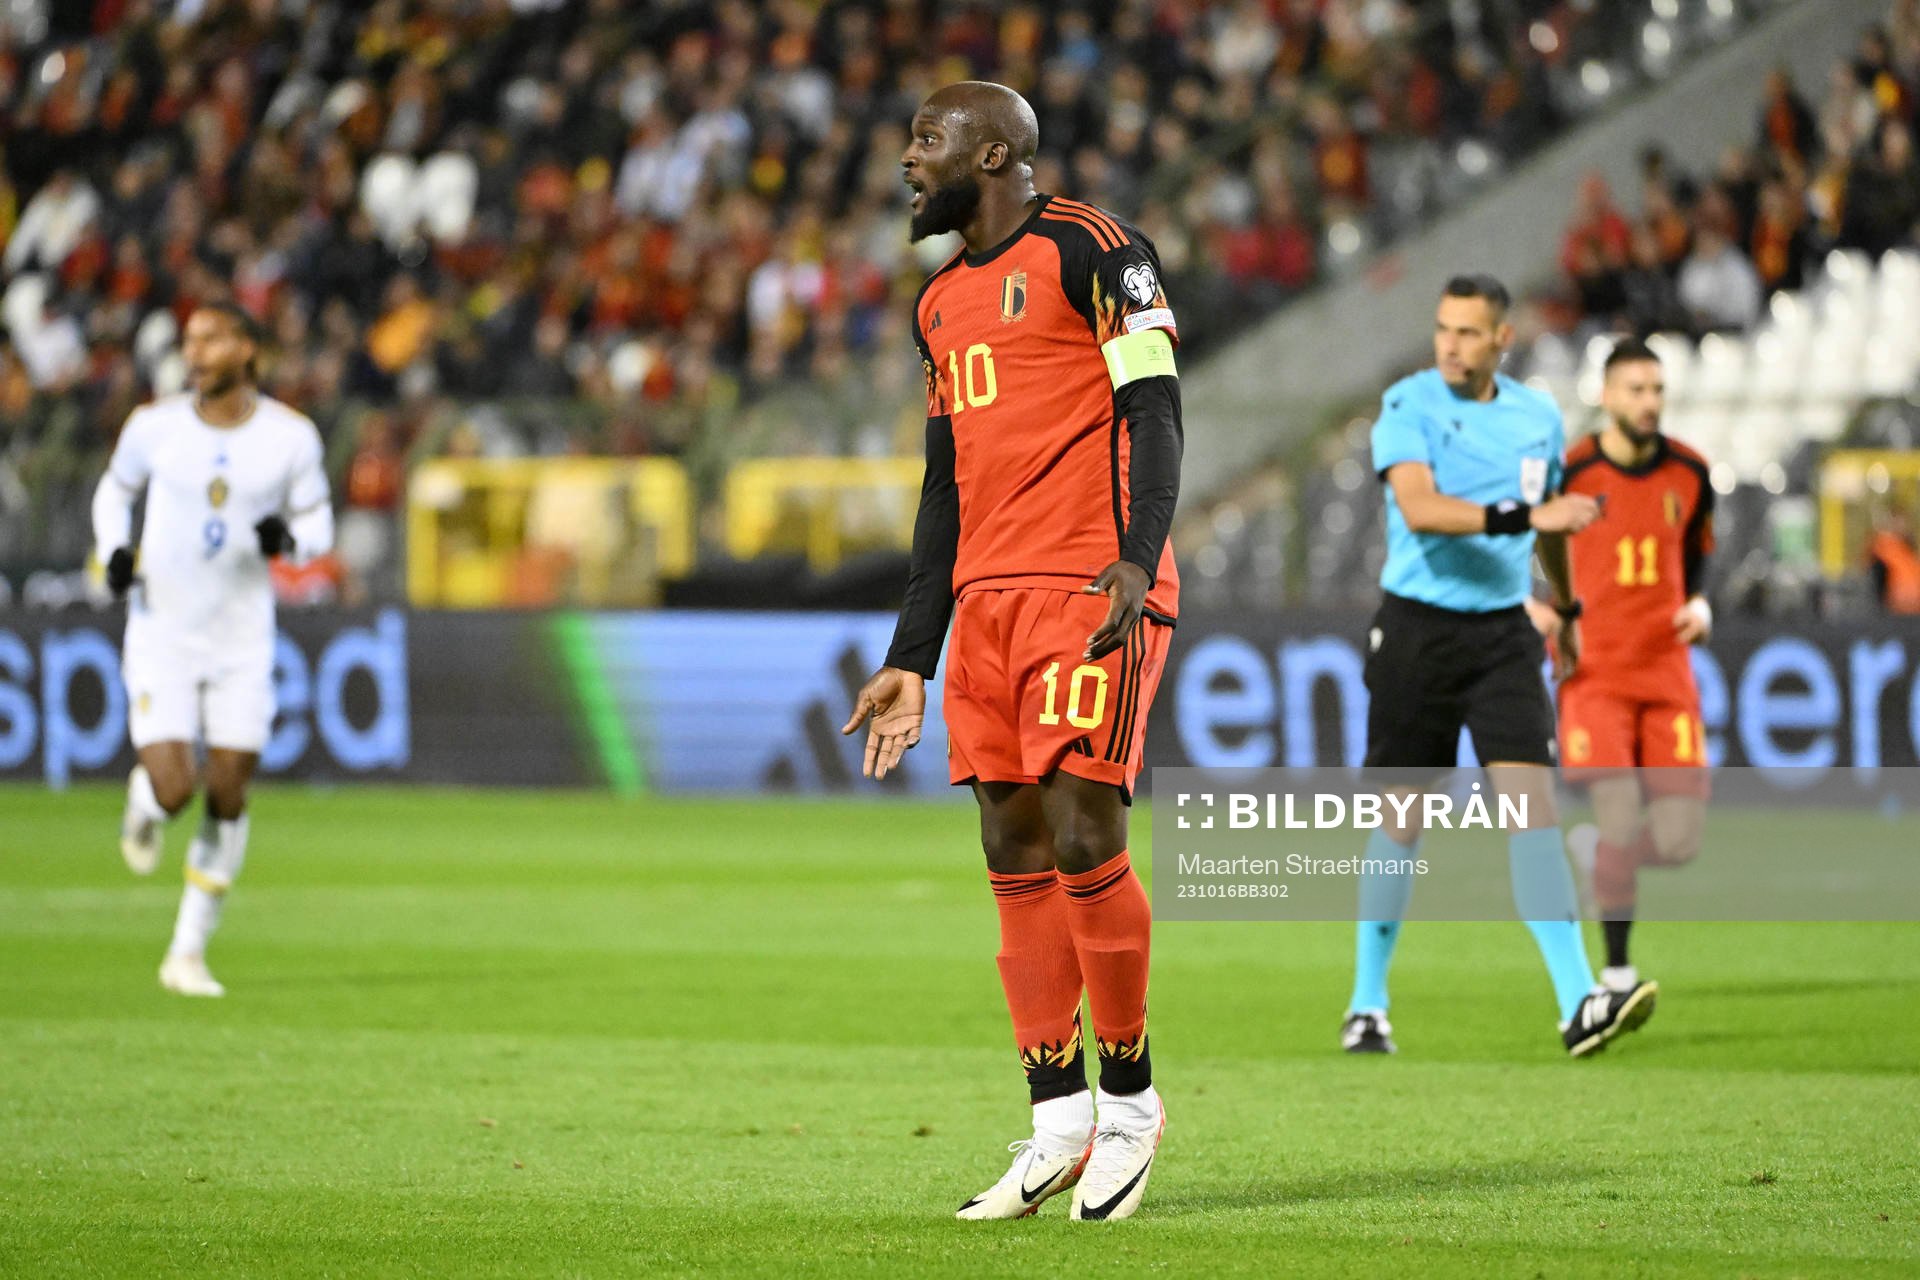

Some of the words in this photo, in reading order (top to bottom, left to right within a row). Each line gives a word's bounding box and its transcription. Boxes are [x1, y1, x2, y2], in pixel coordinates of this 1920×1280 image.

[949, 343, 998, 414] 10
[1615, 536, 1660, 586] 11
[1039, 662, 1109, 729] 10
